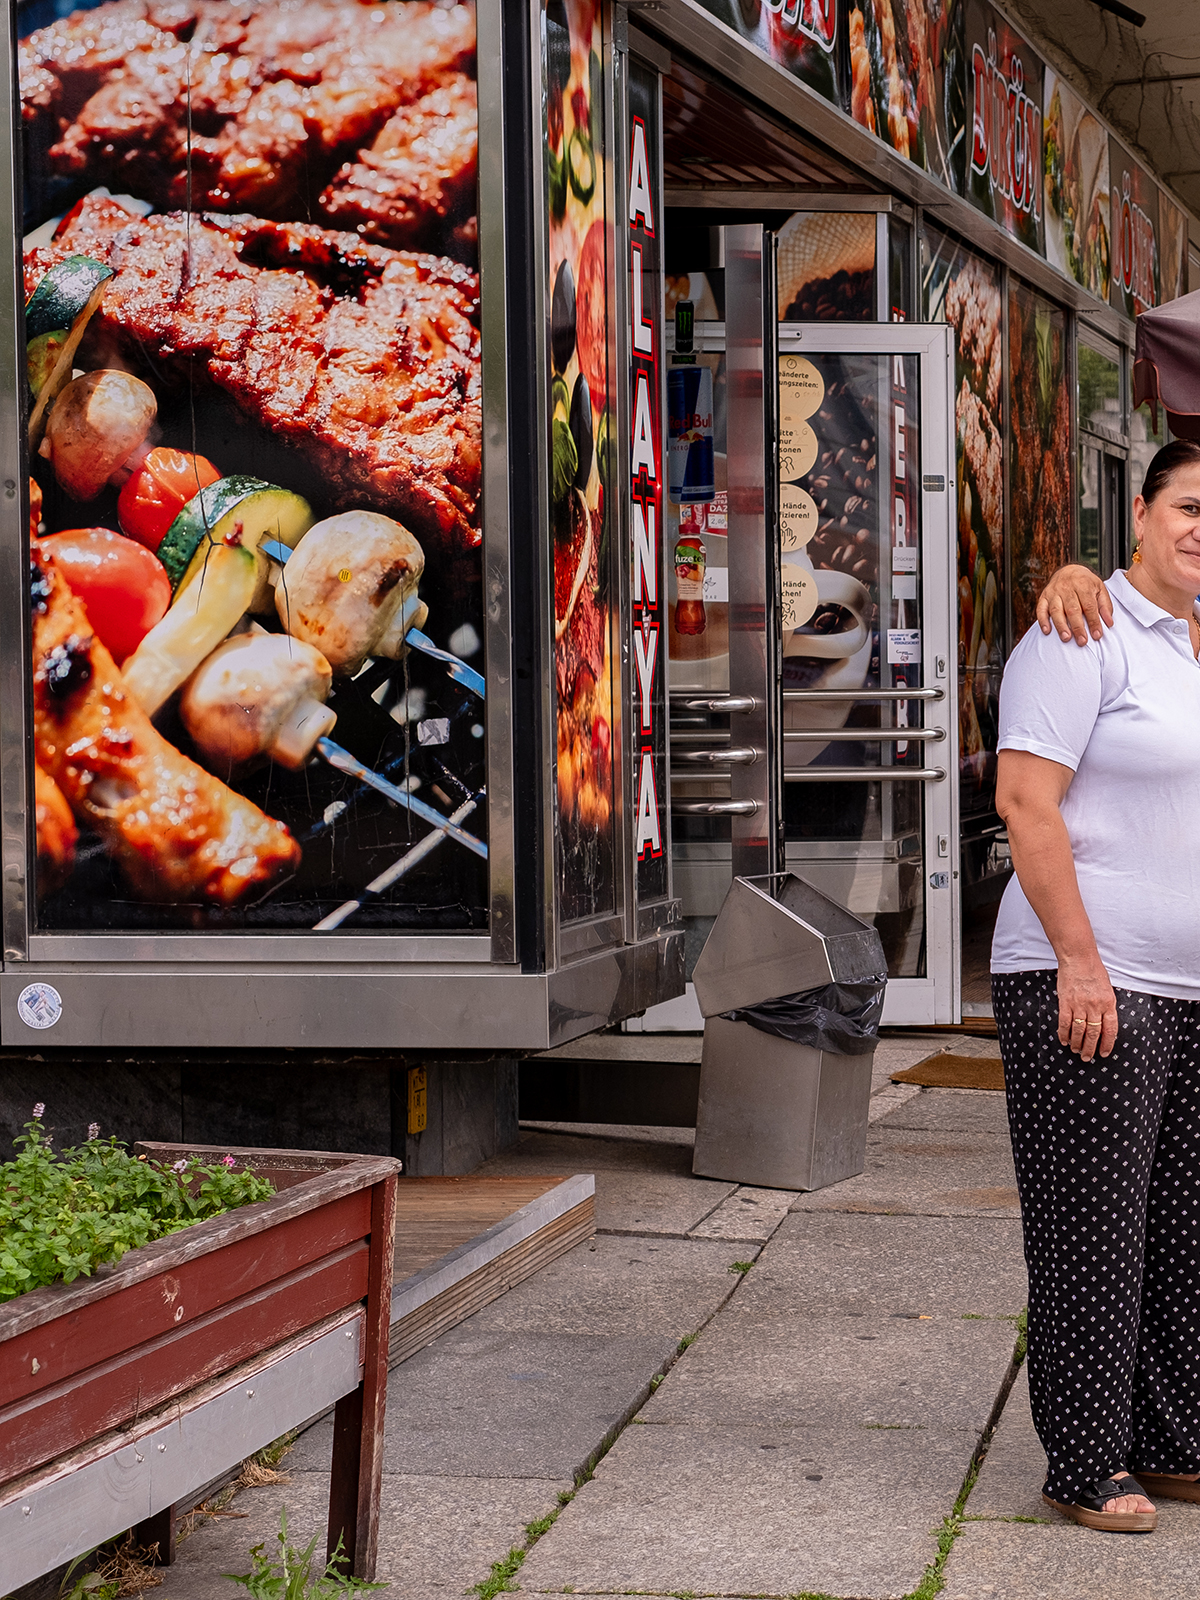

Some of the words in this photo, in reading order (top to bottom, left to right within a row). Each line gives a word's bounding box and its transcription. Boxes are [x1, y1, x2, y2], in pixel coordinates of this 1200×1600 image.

[1113, 170, 1156, 310] DÖNER
[629, 115, 662, 861] ALANYA
[669, 413, 690, 429] Red
[692, 413, 712, 429] Bull
